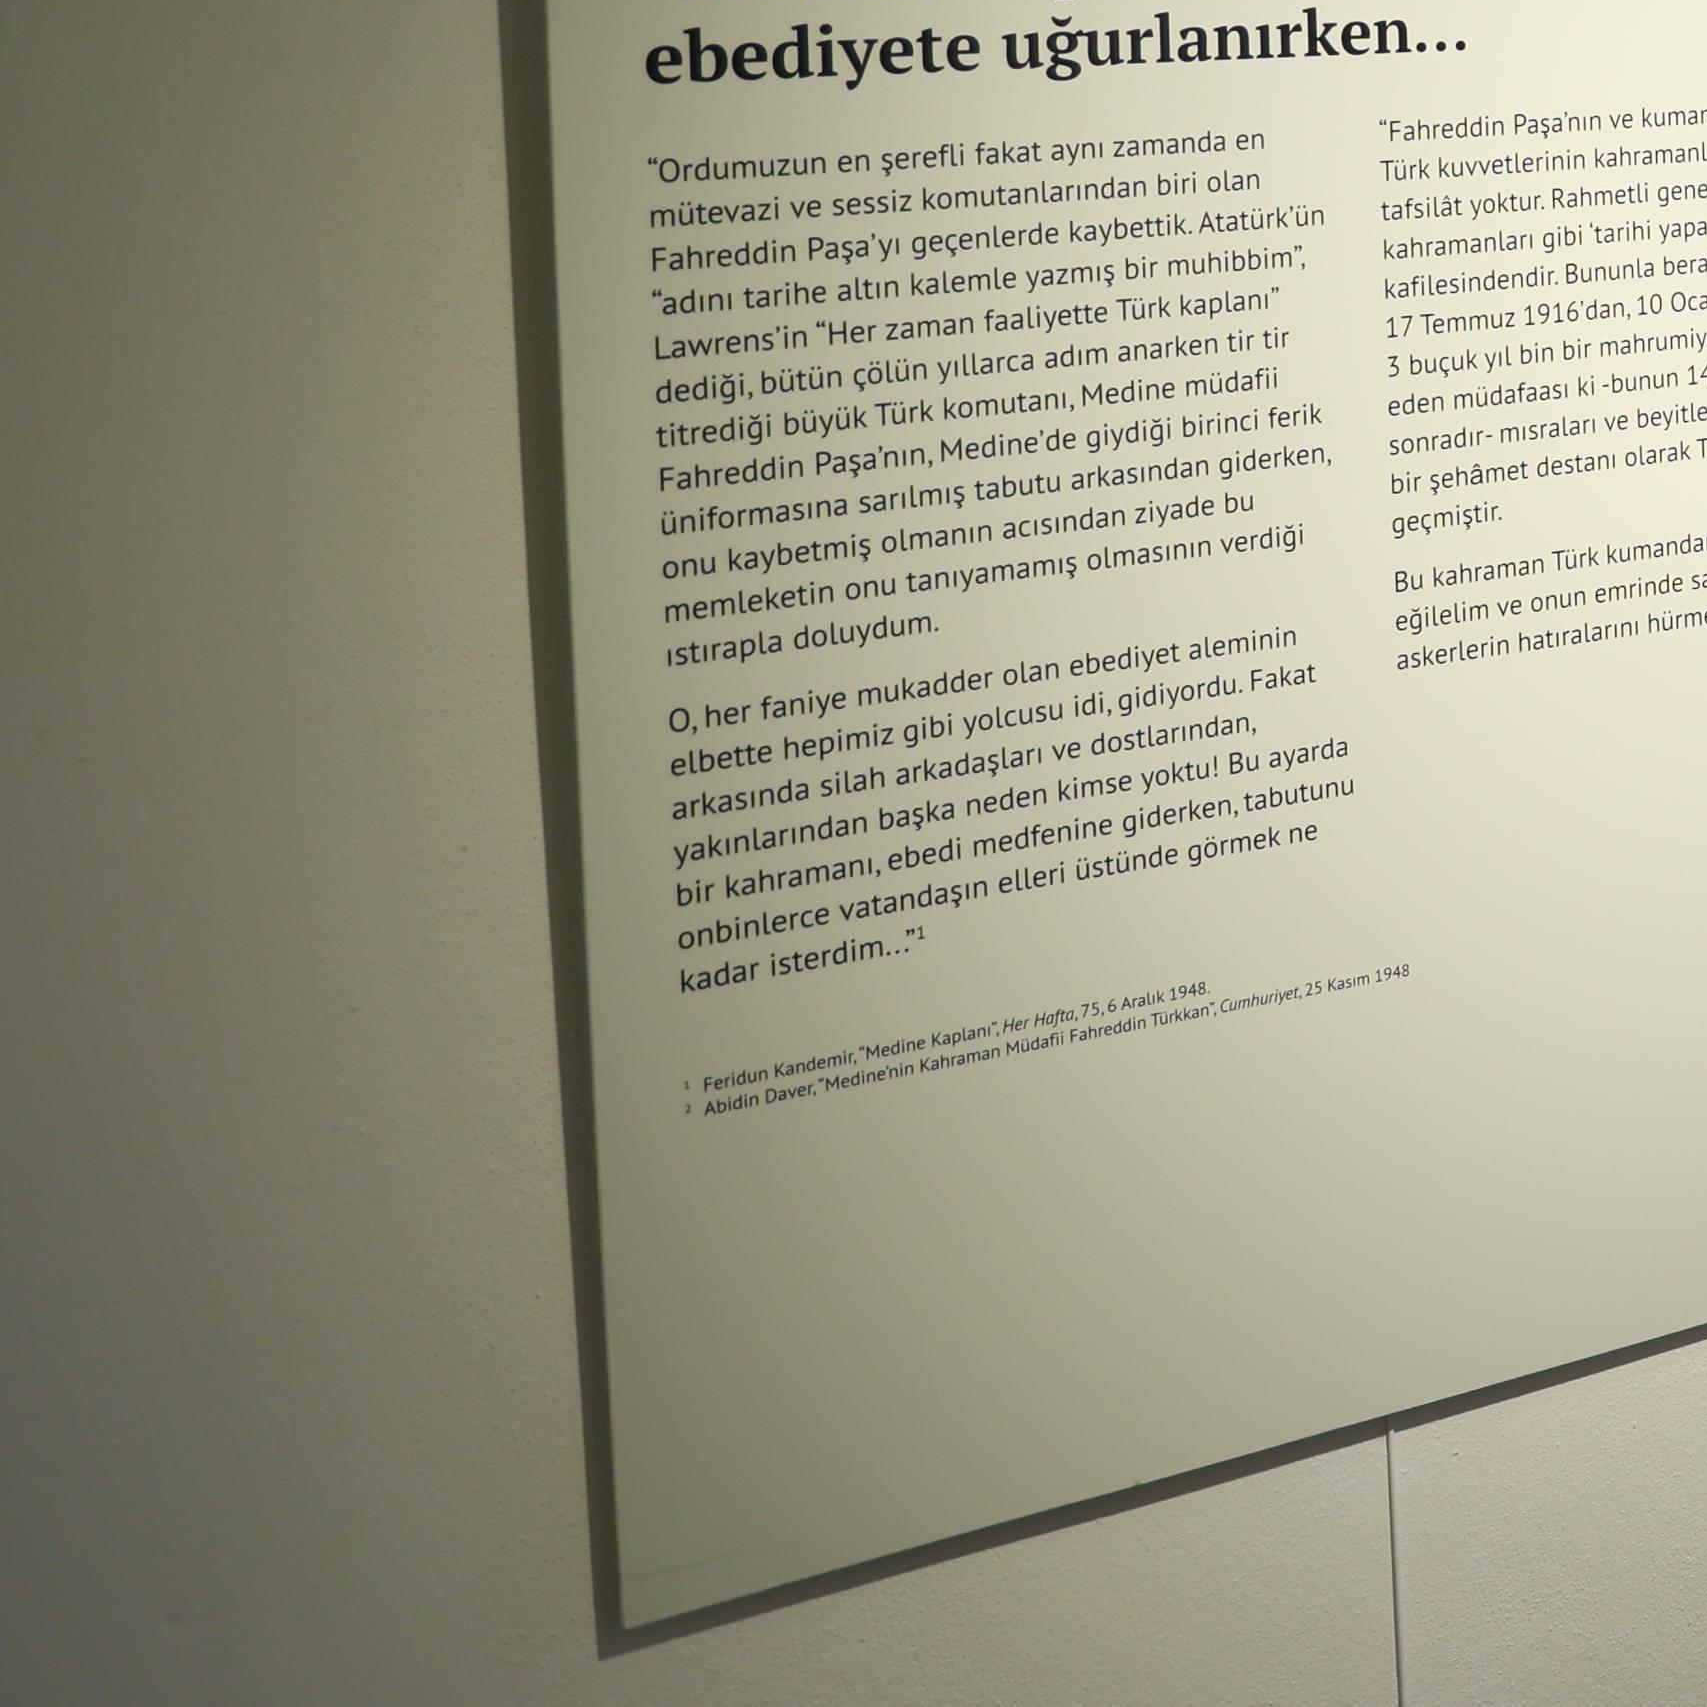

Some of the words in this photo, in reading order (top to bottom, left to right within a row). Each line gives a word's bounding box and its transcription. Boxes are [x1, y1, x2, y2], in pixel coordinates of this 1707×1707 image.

[645, 22, 980, 91] ebediyete
[1000, 6, 1466, 82] uğurlanırken...
[647, 155, 827, 184] “Ordumuzun
[836, 153, 870, 173] en
[880, 142, 965, 177] şerefli
[974, 140, 1043, 166] fakat
[1050, 141, 1104, 167] aynı
[1112, 129, 1226, 158] zamanda
[1235, 132, 1265, 151] en
[1378, 114, 1505, 143] “Fahreddin
[1513, 110, 1602, 139] Paşa’nın
[1608, 112, 1634, 130] ve
[649, 195, 779, 228] mütevazi
[789, 198, 822, 219] ve
[831, 188, 913, 217] sessiz
[921, 175, 1147, 211] komutanlarından
[1156, 171, 1197, 197] biri
[1206, 169, 1260, 193] olan
[651, 238, 796, 272] Fahreddin
[807, 232, 900, 265] Paşa’yı
[910, 221, 1059, 260] geçenlerde
[1068, 212, 1193, 248] kaybettik.
[1198, 204, 1325, 234] Atatürk’ün
[1382, 229, 1534, 261] kahramanları
[1542, 223, 1583, 254] gibi
[654, 324, 808, 360] Lawrens’in
[815, 319, 878, 346] “Her
[884, 316, 974, 341] zaman
[982, 303, 1108, 334] faaliyette
[1114, 295, 1172, 322] Türk
[1179, 285, 1280, 320] kaplanı”
[1385, 314, 1413, 339] 17
[1418, 311, 1516, 336] Temmuz
[1523, 298, 1631, 326] 1916’dan,
[1636, 292, 1663, 316] 10
[655, 412, 771, 448] titrediği
[783, 404, 868, 439] büyük
[873, 398, 934, 427] Türk
[942, 391, 1075, 421] komutanı,
[1081, 378, 1176, 408] Medine
[1185, 366, 1278, 398] müdafii
[660, 497, 848, 536] üniformasına
[858, 484, 966, 514] sarılmış
[973, 473, 1061, 501] tabutu
[1070, 456, 1210, 491] arkasından
[1218, 445, 1332, 481] giderken,
[1390, 470, 1422, 495] bir
[1429, 460, 1529, 496] şehâmet
[1536, 452, 1616, 478] destanı
[1624, 439, 1691, 467] olarak
[666, 629, 783, 667] ıstırapla
[793, 614, 940, 650] doluydum.
[669, 743, 773, 777] elbette
[782, 722, 895, 761] hepimiz
[902, 711, 953, 749] gibi
[962, 702, 1063, 740] yolcusu
[1073, 690, 1112, 718] idi,
[1117, 674, 1243, 717] gidiyordu.
[1250, 663, 1317, 692] Fakat
[702, 1068, 769, 1093] Feridun
[773, 1049, 858, 1079] Kandemir,
[857, 1037, 927, 1061] “Medine
[1002, 1016, 1031, 1035] Her
[1033, 1007, 1079, 1028] Hafta,
[1080, 1000, 1105, 1019] 75,
[1106, 997, 1117, 1013] 6
[1120, 989, 1166, 1011] Aralık
[1168, 980, 1211, 1002] 1948.
[703, 1092, 760, 1117] Abidin
[764, 1083, 817, 1105] Daver,
[919, 1046, 1001, 1074] Kahraman
[1005, 1030, 1065, 1057] Müdafii
[1069, 1016, 1147, 1044] Fahreddin
[1219, 986, 1303, 1014] Cumhuriyet,
[1304, 979, 1323, 997] 25
[1326, 973, 1370, 993] Kasım
[1374, 962, 1410, 983] 1948
